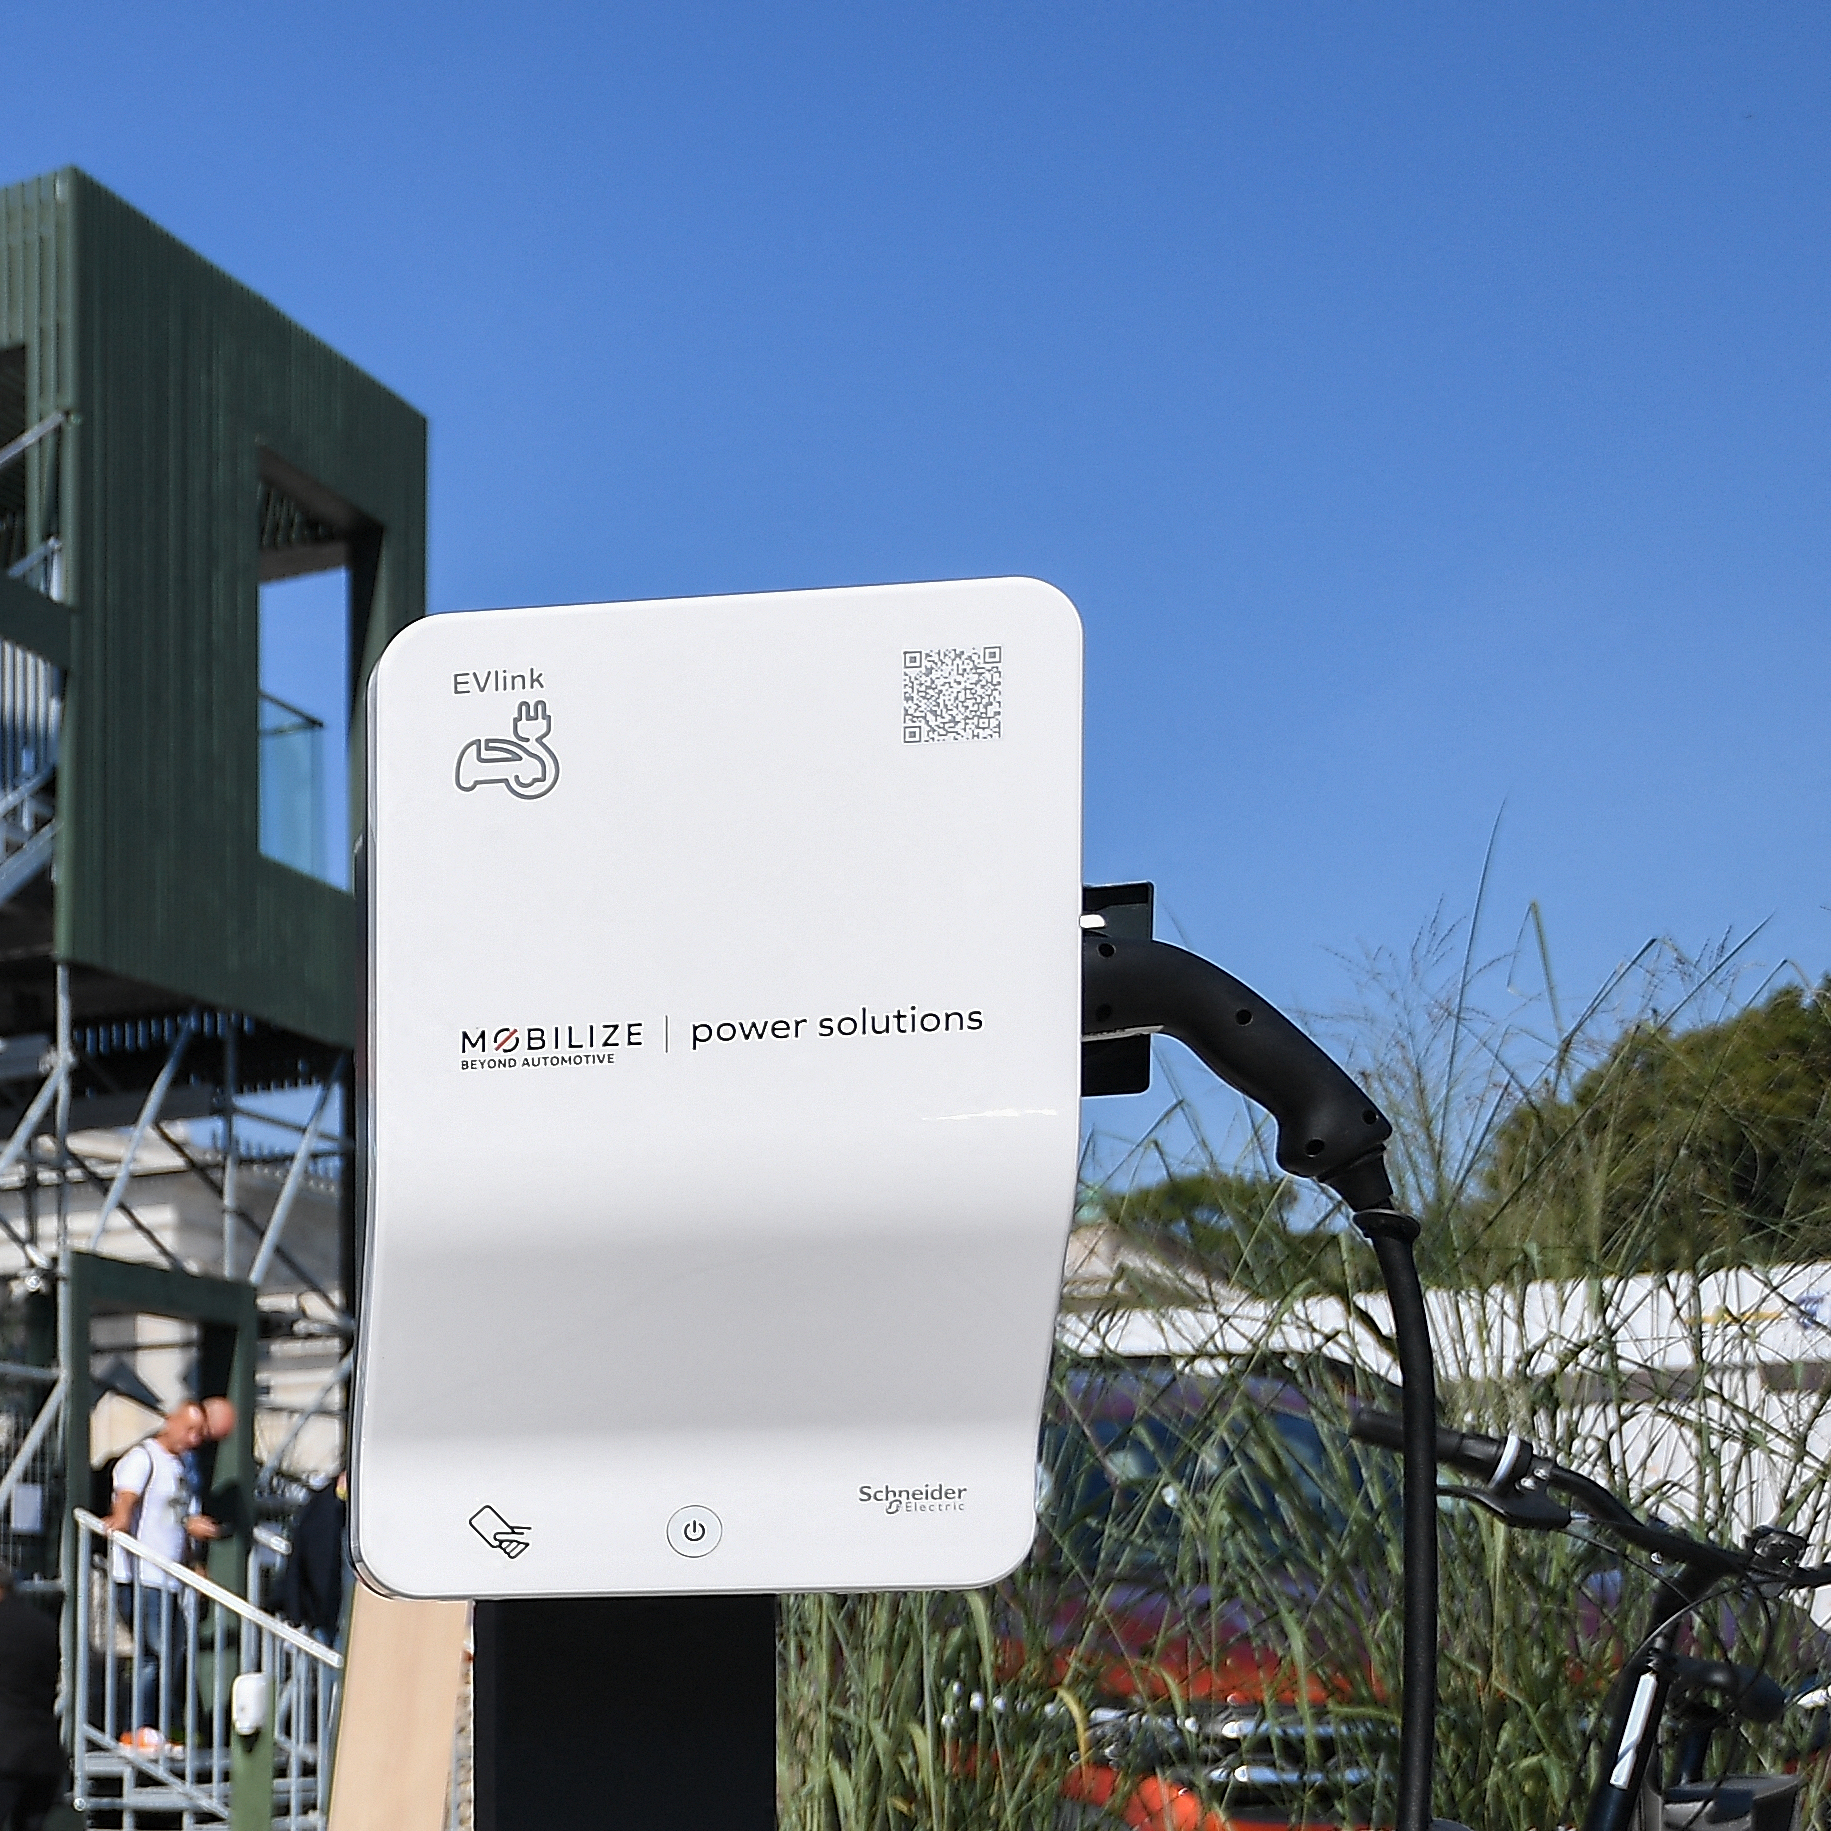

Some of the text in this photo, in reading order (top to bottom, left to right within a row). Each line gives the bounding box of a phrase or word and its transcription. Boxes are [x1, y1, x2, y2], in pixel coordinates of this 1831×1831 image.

[453, 667, 544, 695] EVlink
[692, 1018, 808, 1051] power
[818, 1005, 984, 1037] solutions
[461, 1053, 615, 1070] BEYOND AUTOMOTIVE
[859, 1483, 968, 1502] Schneider
[905, 1501, 965, 1513] Electric
